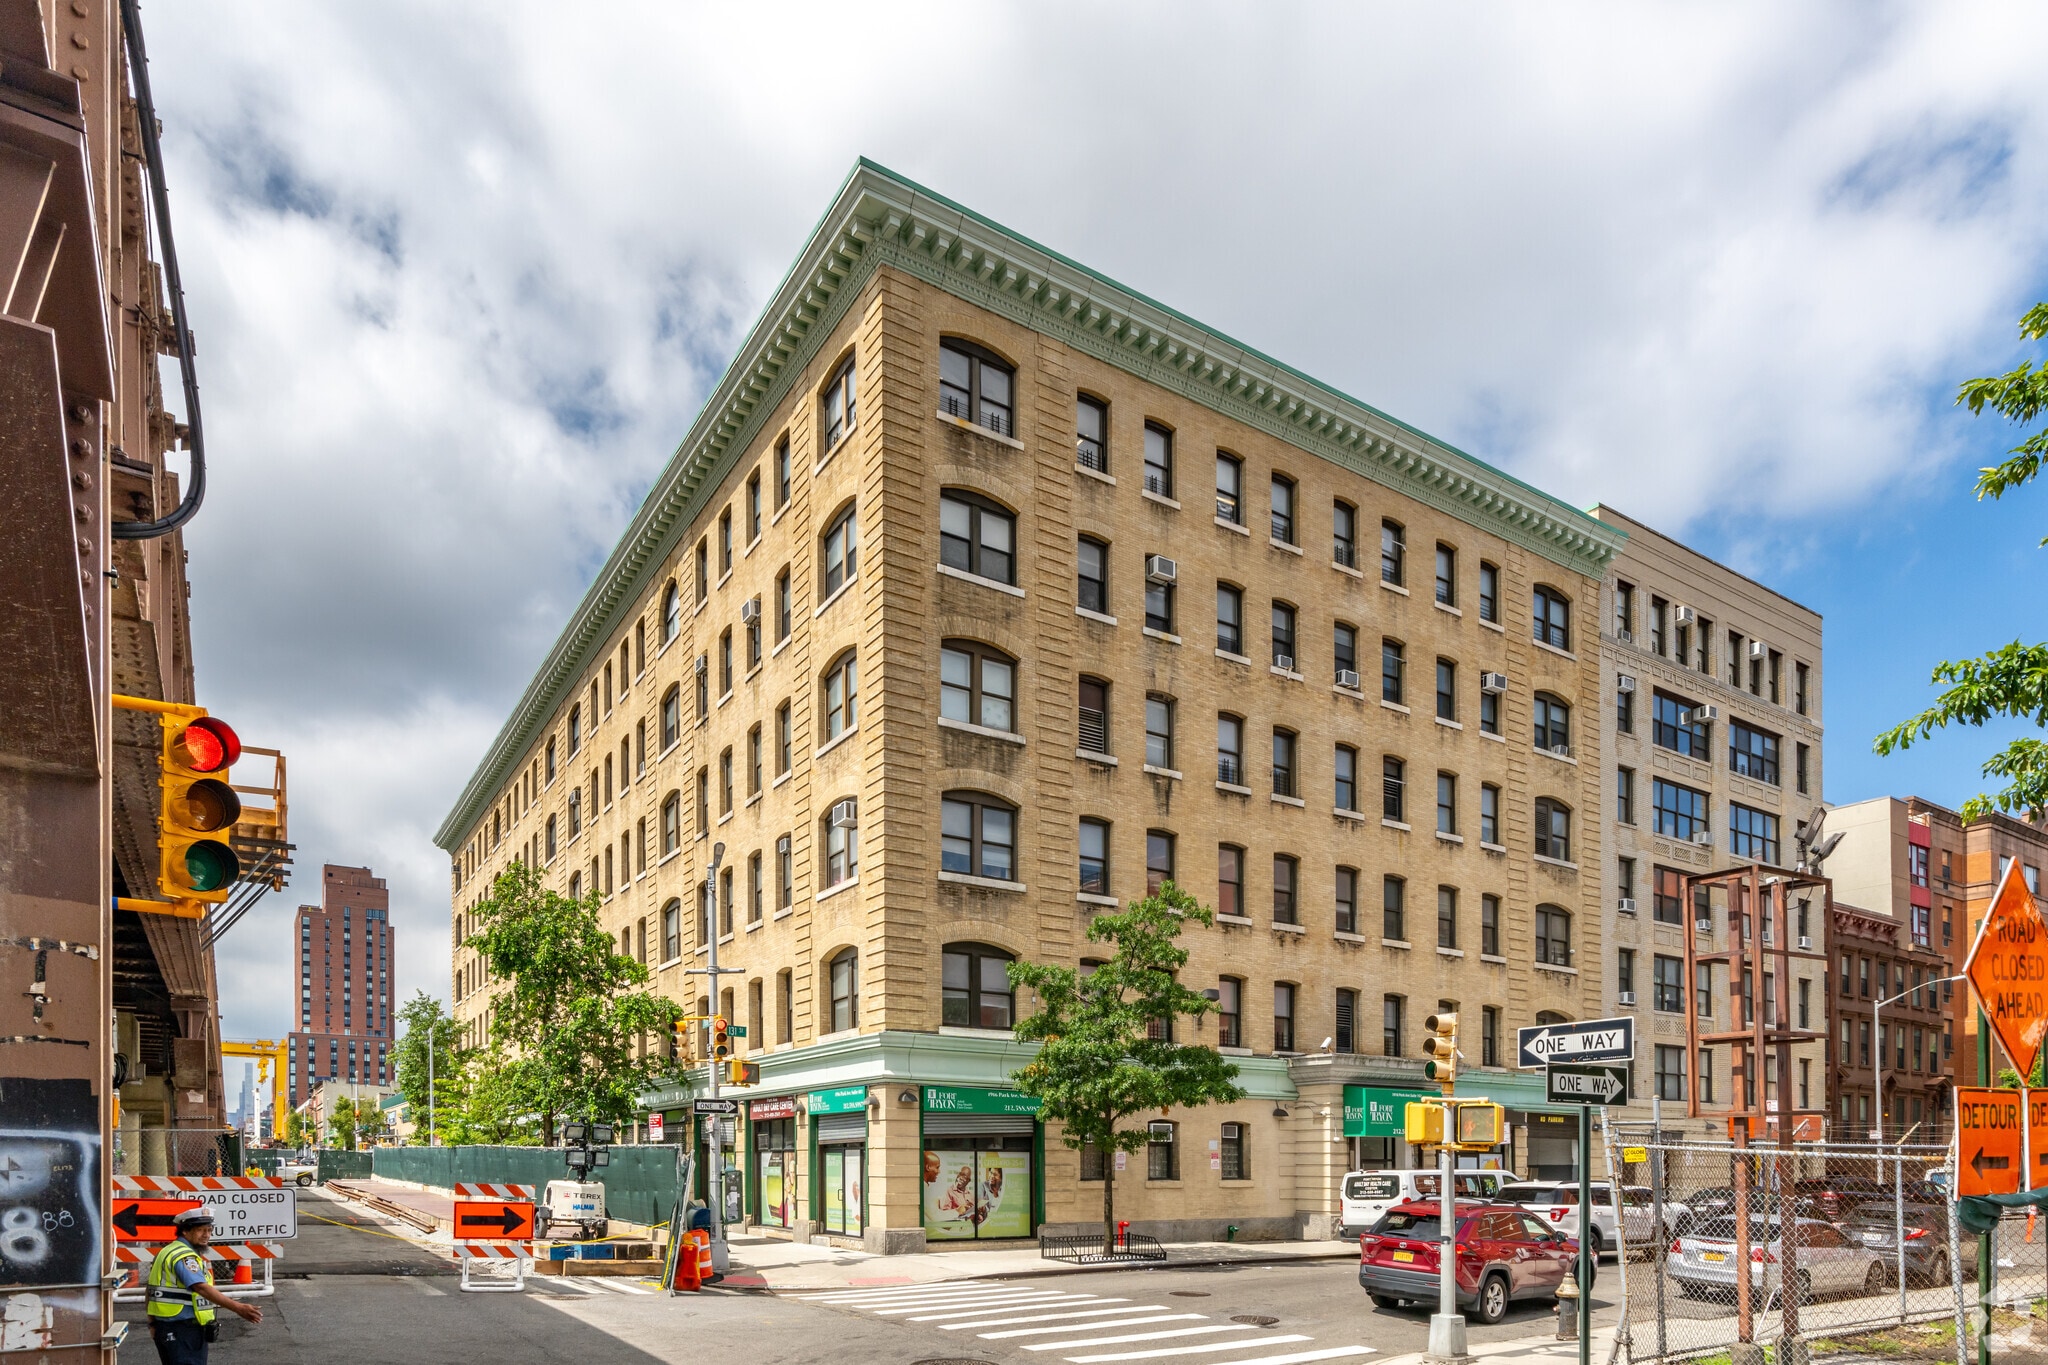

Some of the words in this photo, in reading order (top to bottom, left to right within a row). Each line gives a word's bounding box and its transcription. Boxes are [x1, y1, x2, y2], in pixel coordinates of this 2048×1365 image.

[1998, 916, 2036, 943] ROAD
[1992, 955, 2044, 981] CLOSED
[1997, 992, 2043, 1018] AHEAD
[728, 1026, 737, 1036] 131
[1536, 1037, 1566, 1053] ONE
[1582, 1032, 1616, 1049] WAY
[1560, 1076, 1582, 1091] ONE
[1592, 1078, 1616, 1094] WAY
[928, 1099, 956, 1109] TRYON
[1370, 1112, 1393, 1121] TRYON
[1963, 1103, 2017, 1128] DETOUR
[232, 1194, 285, 1203] CLOSED
[229, 1210, 247, 1220] TO
[230, 1225, 287, 1236] TRAFFIC
